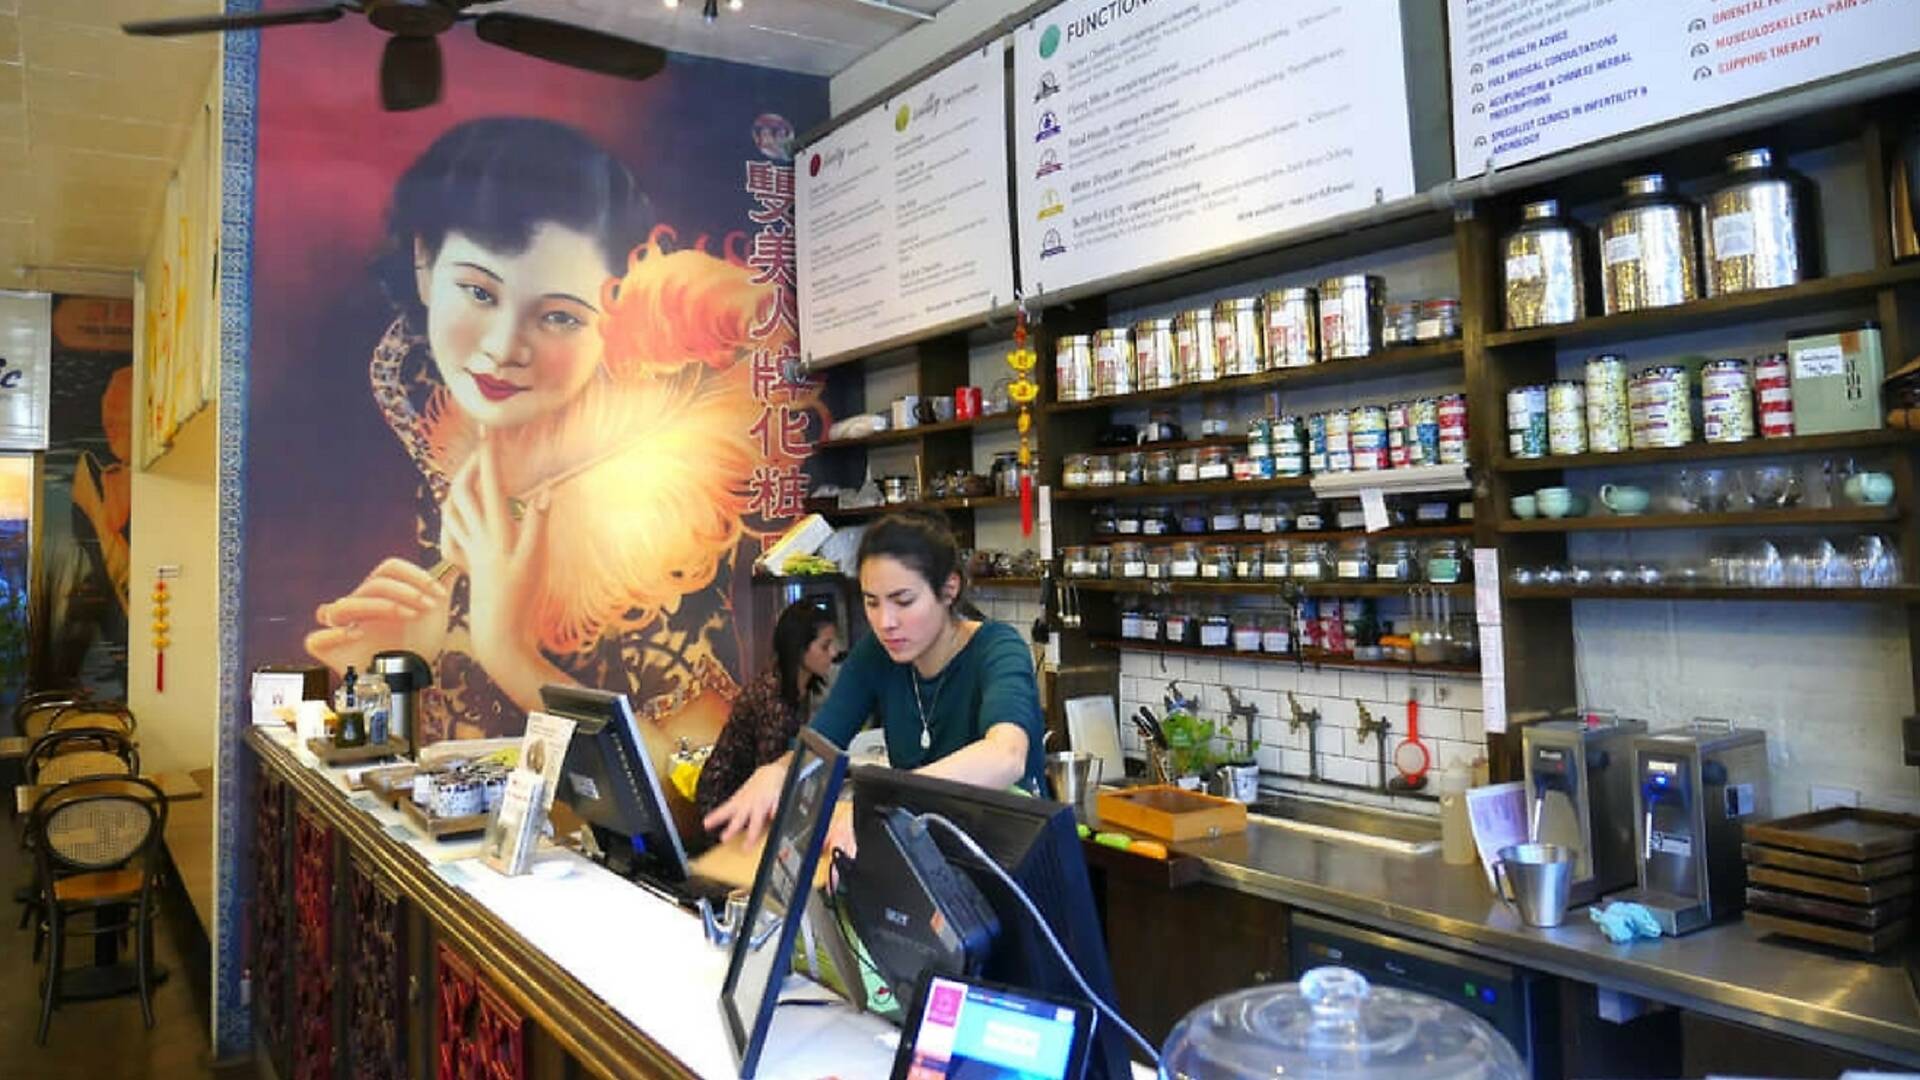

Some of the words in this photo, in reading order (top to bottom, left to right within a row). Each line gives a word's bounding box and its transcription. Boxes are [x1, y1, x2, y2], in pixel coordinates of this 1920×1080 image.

[1507, 42, 1536, 59] HEALTH
[1539, 30, 1567, 48] ADVICE
[1716, 7, 1824, 48] MUSCULOSKELETAL
[1507, 61, 1543, 80] MEDICAL
[1545, 34, 1618, 68] CONSULTATIONS
[1718, 51, 1767, 74] CUPPING
[1770, 35, 1820, 58] THERAPY
[1489, 80, 1546, 107] ACUPUNCTURE
[1557, 64, 1593, 84] CHINESE
[1596, 52, 1632, 70] HERBAL
[1491, 119, 1535, 143] SPECIALIST
[1537, 109, 1570, 126] CLINICS
[1572, 106, 1582, 115] IN
[1584, 88, 1637, 113] INFERTILITY
[747, 160, 814, 577] 雙美人牌化粧
